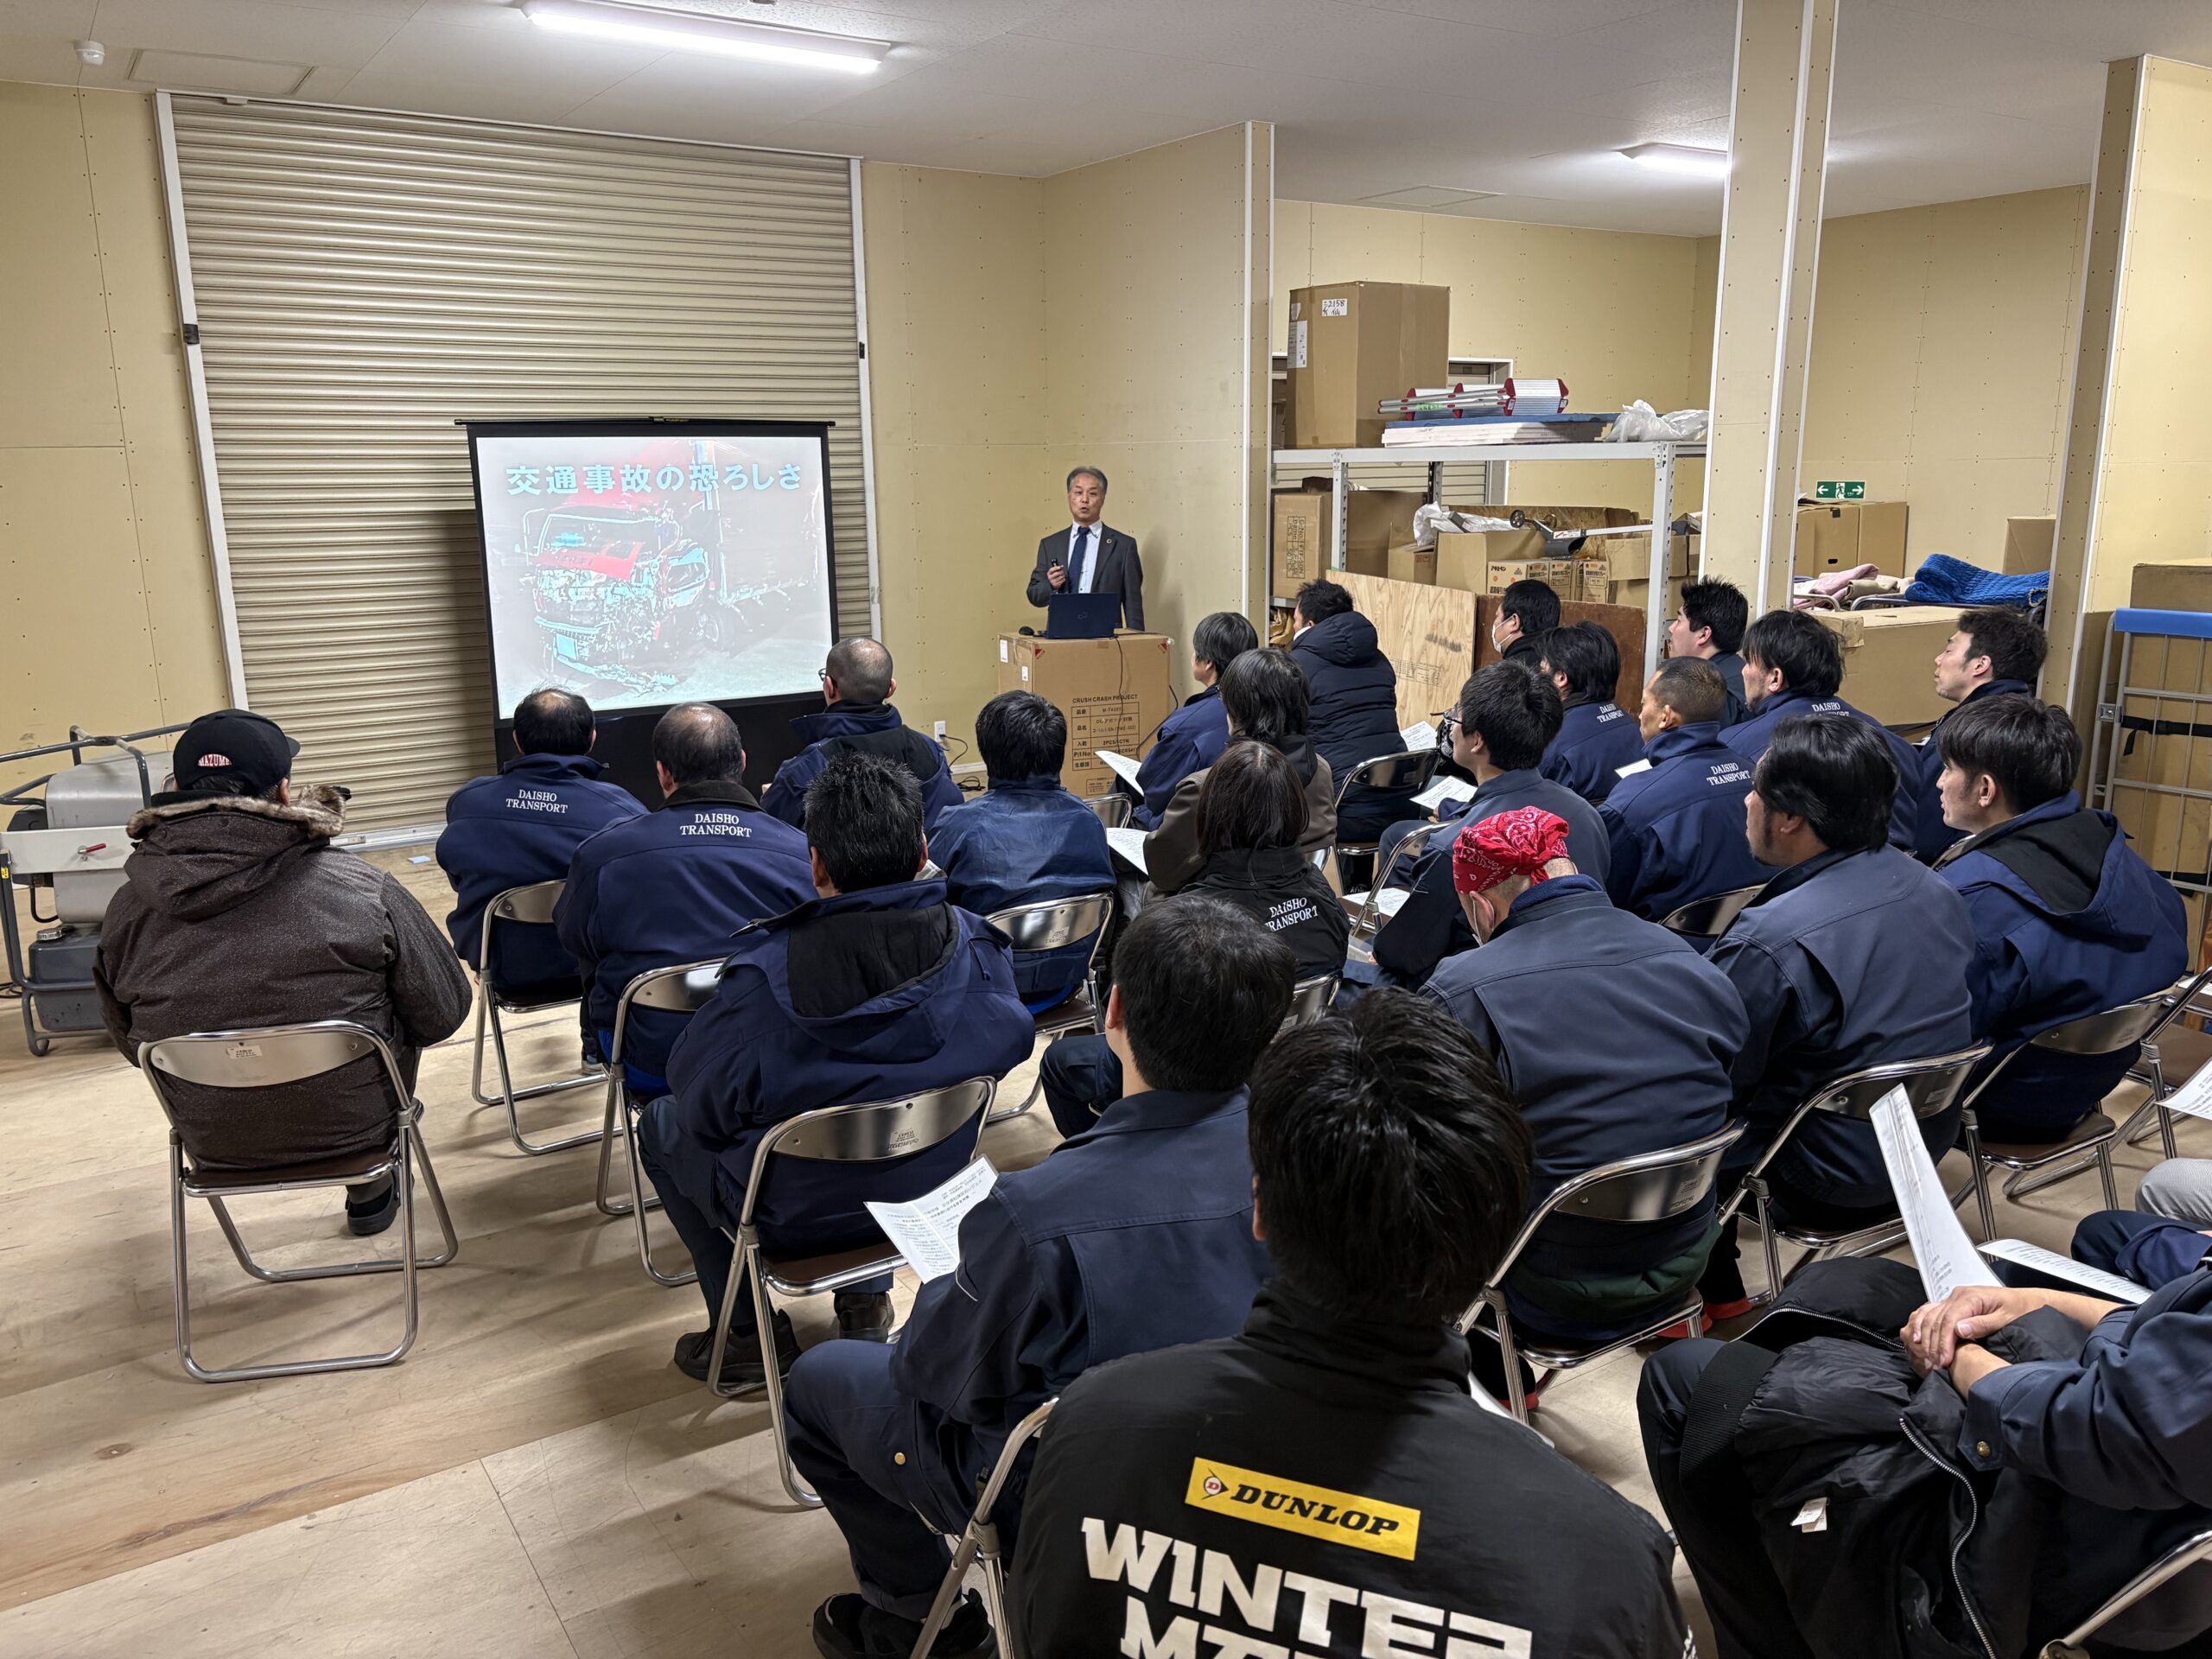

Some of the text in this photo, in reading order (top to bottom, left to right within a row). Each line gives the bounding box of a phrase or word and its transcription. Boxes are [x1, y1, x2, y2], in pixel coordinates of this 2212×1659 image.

[505, 463, 802, 495] 交通事故の恐ろしさ
[1811, 702, 1840, 712] DAISHO
[1710, 762, 1739, 775] DAISHO
[1706, 770, 1751, 785] TRANSPORT
[518, 789, 557, 803] DAISHO
[505, 798, 569, 814] TRANSPORT
[695, 813, 740, 825] DAISHO
[679, 824, 753, 838] TRANSPORT
[1269, 897, 1307, 918] DAISHO
[1230, 1484, 1400, 1535] DUNLOP
